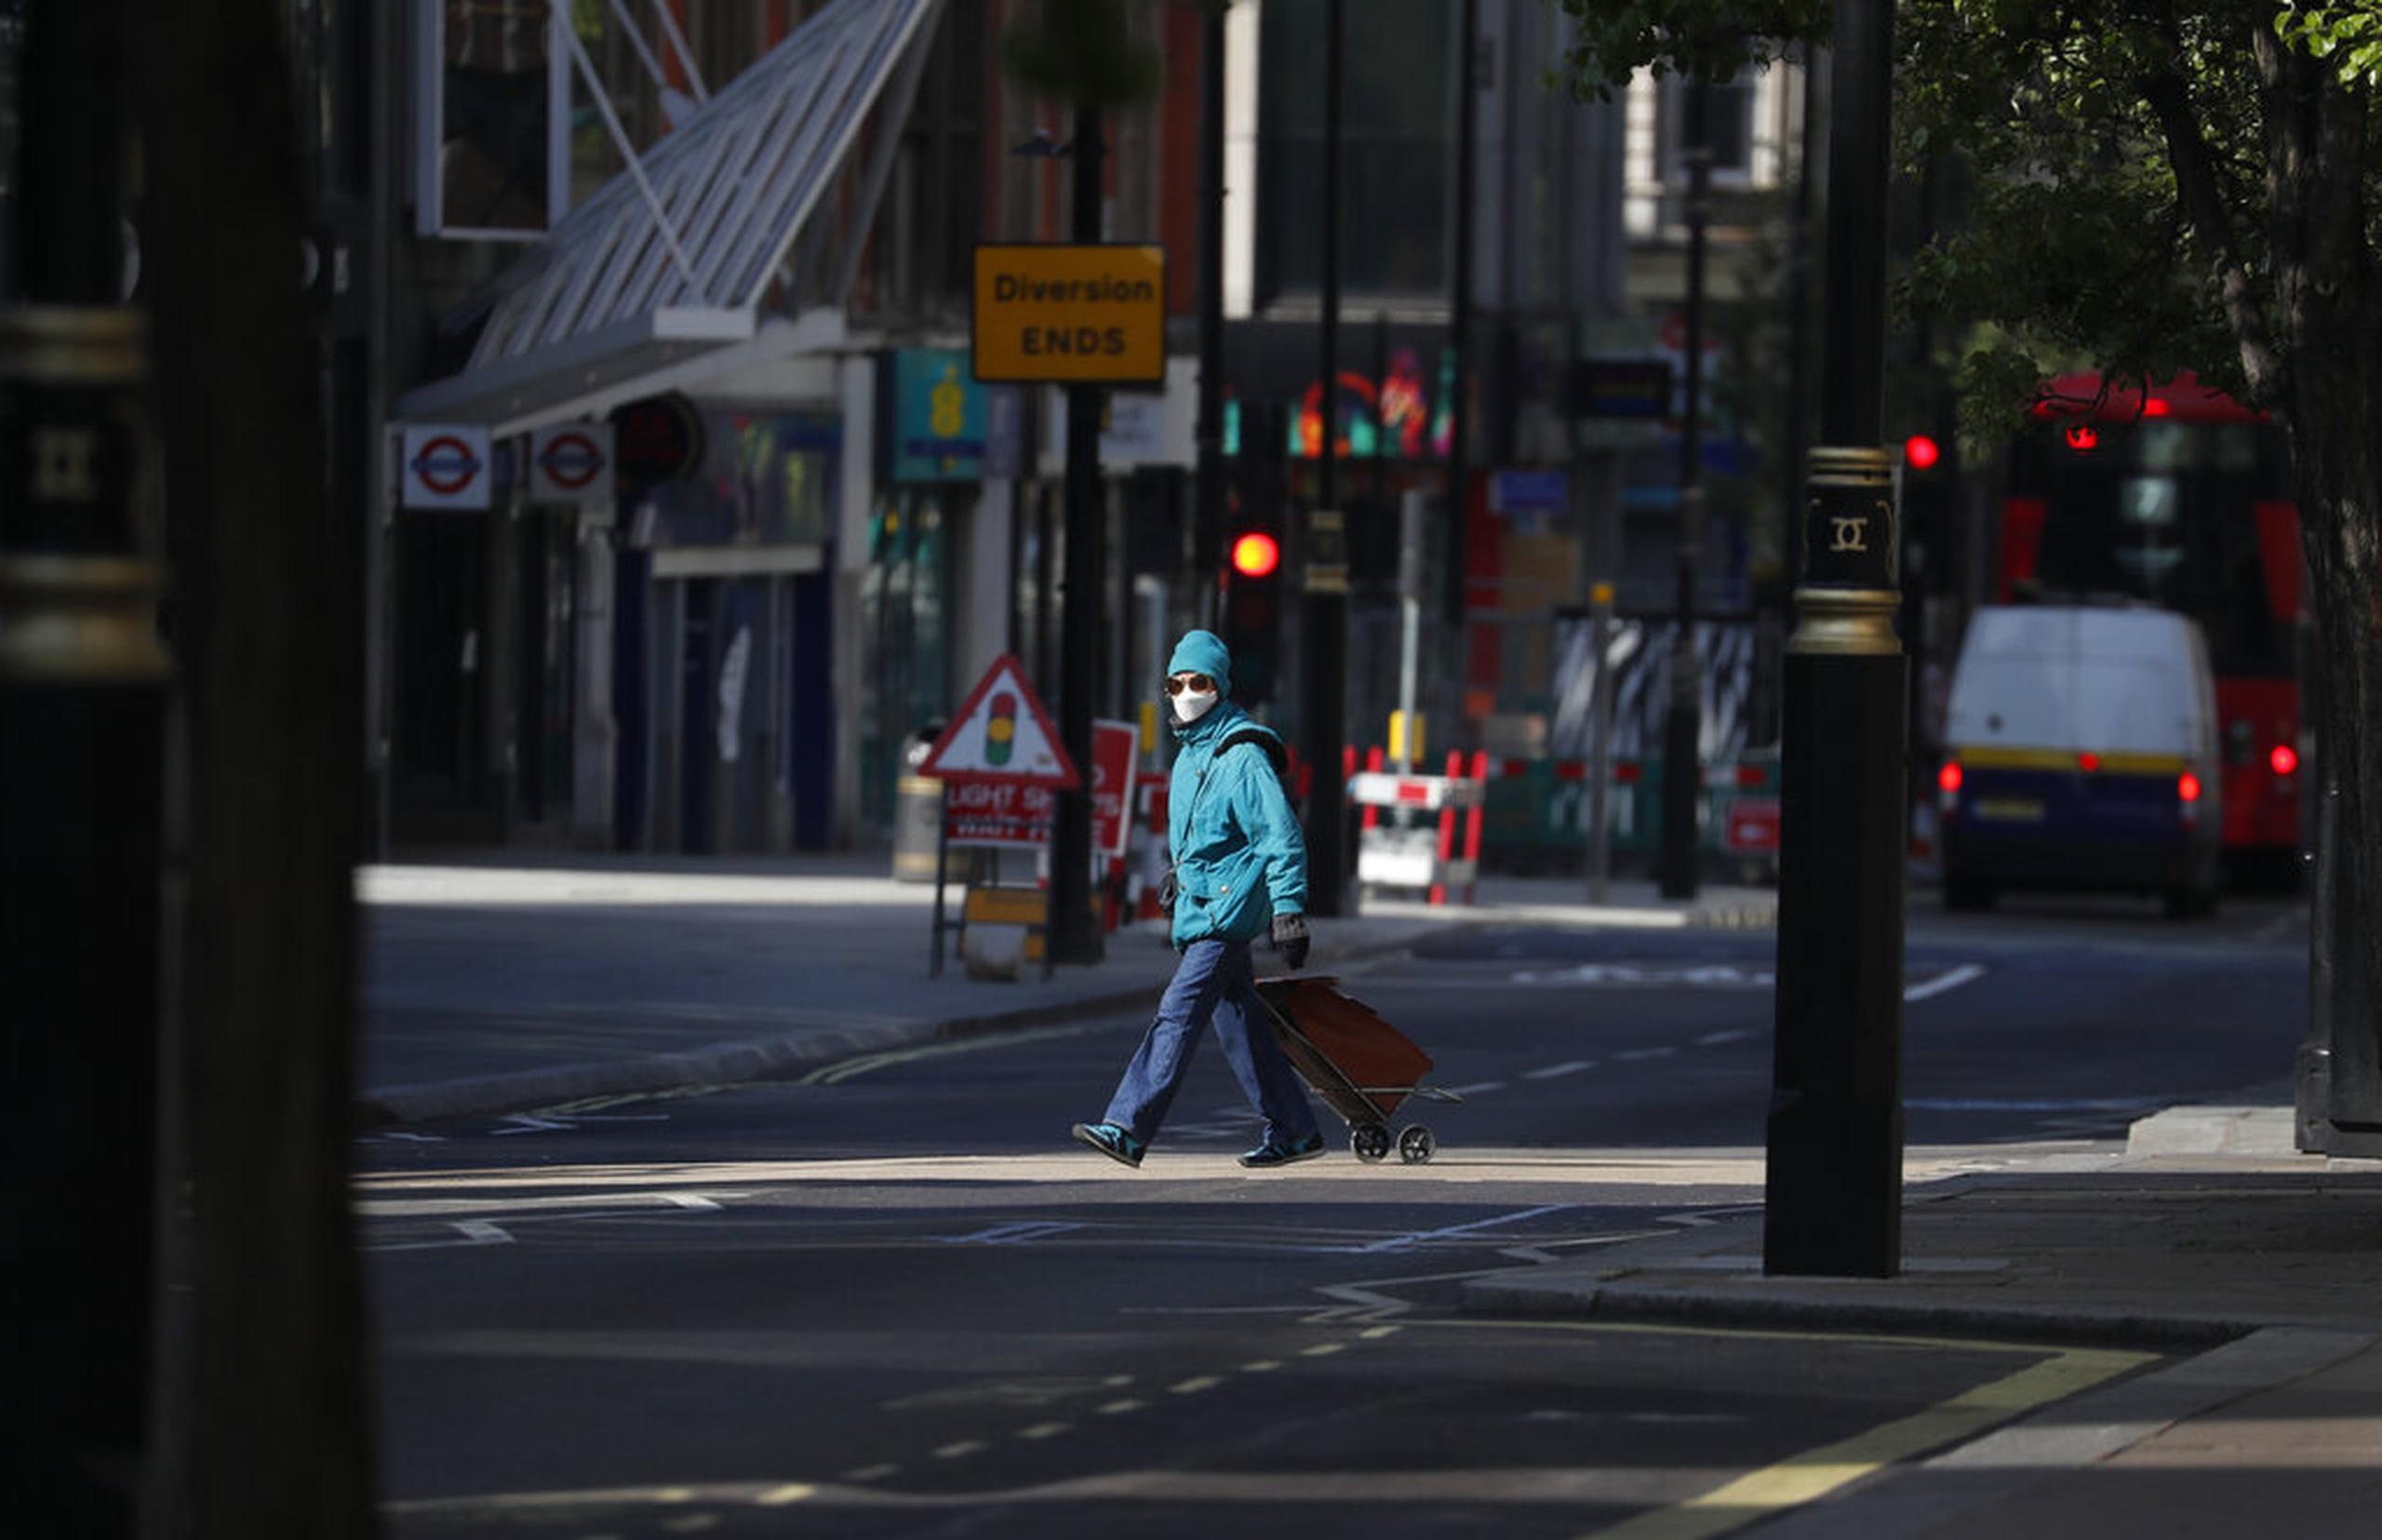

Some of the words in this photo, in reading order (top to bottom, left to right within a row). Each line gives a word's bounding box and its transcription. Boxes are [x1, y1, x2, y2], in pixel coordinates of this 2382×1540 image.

[995, 274, 1153, 302] Diversion
[1022, 328, 1126, 355] ENDS
[947, 784, 1015, 808] LIGHT
